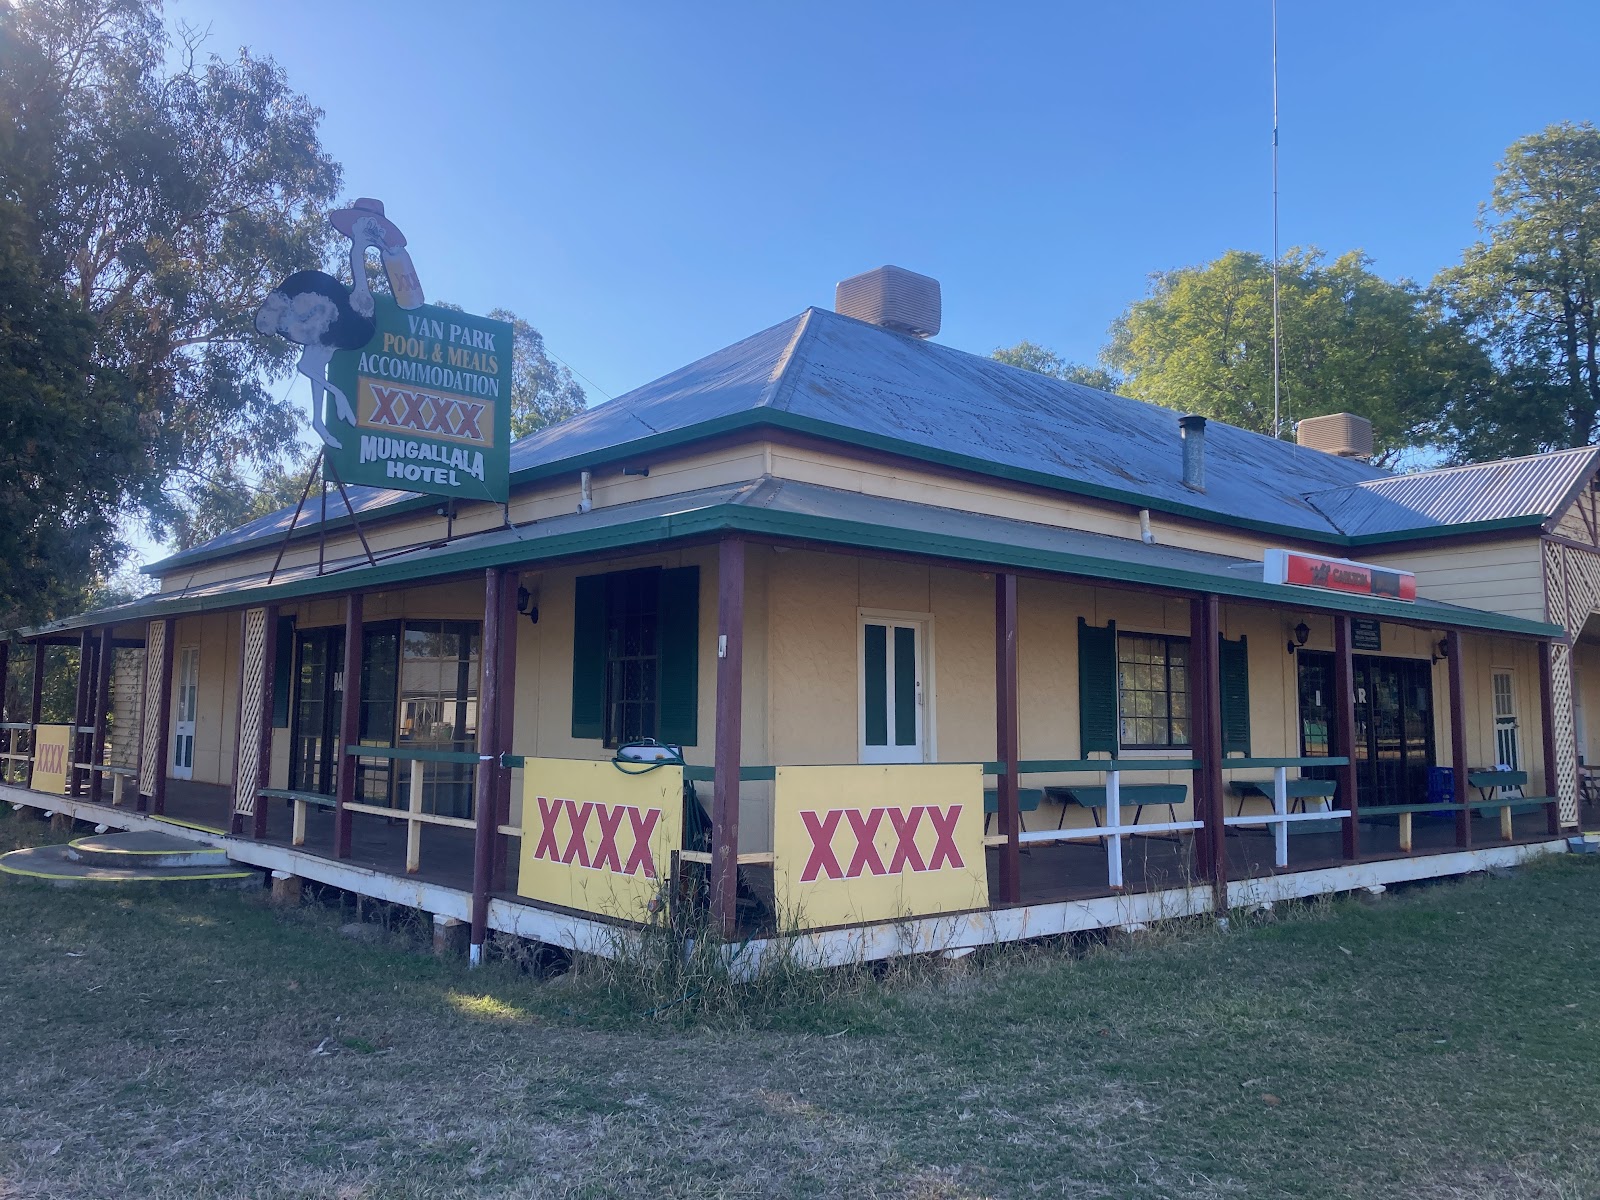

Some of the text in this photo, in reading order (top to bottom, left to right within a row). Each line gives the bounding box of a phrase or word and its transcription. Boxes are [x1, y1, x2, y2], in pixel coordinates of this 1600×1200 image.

[382, 332, 499, 375] POOL & MEALS
[408, 314, 496, 352] VAN PARK
[358, 351, 499, 397] ACCOMMODATION
[369, 383, 486, 441] XXXX
[360, 435, 485, 482] MUNGALLALA
[386, 460, 461, 487] HOTEL
[36, 743, 65, 775] XXXX
[532, 796, 662, 880] XXXX
[799, 803, 965, 882] XXXX
